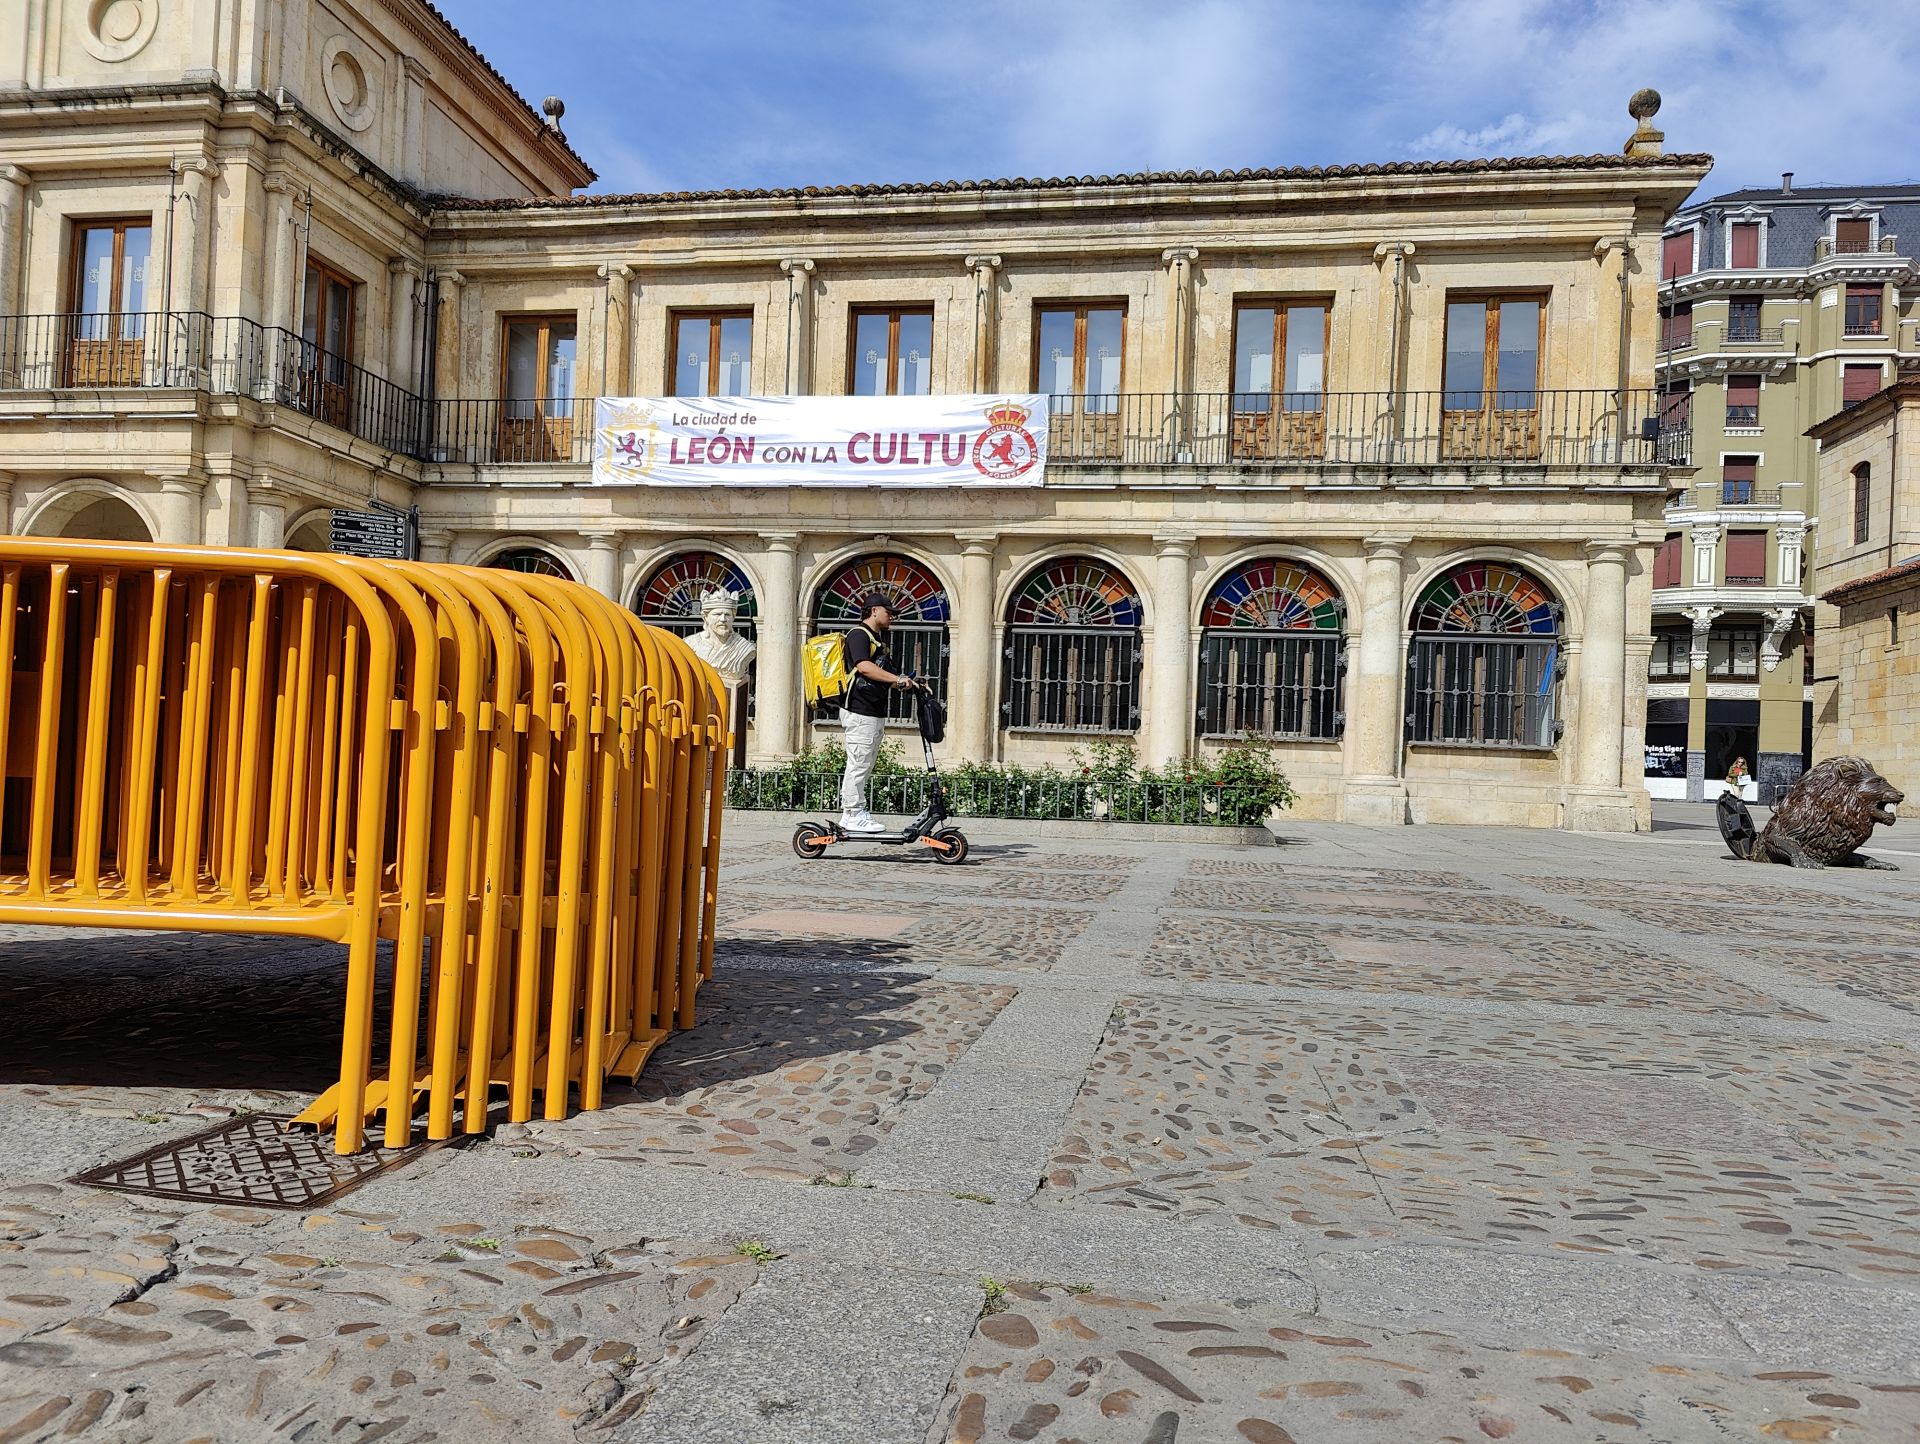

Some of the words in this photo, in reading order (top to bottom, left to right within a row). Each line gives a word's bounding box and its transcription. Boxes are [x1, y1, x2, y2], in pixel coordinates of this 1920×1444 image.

[673, 413, 688, 426] La
[692, 413, 737, 425] ciudad
[740, 413, 757, 425] de
[986, 425, 1026, 436] CULTURAL
[669, 427, 756, 464] LEÓN
[762, 446, 806, 463] CON
[811, 446, 838, 463] LA
[847, 432, 966, 466] CULTU
[1664, 745, 1684, 753] tiger
